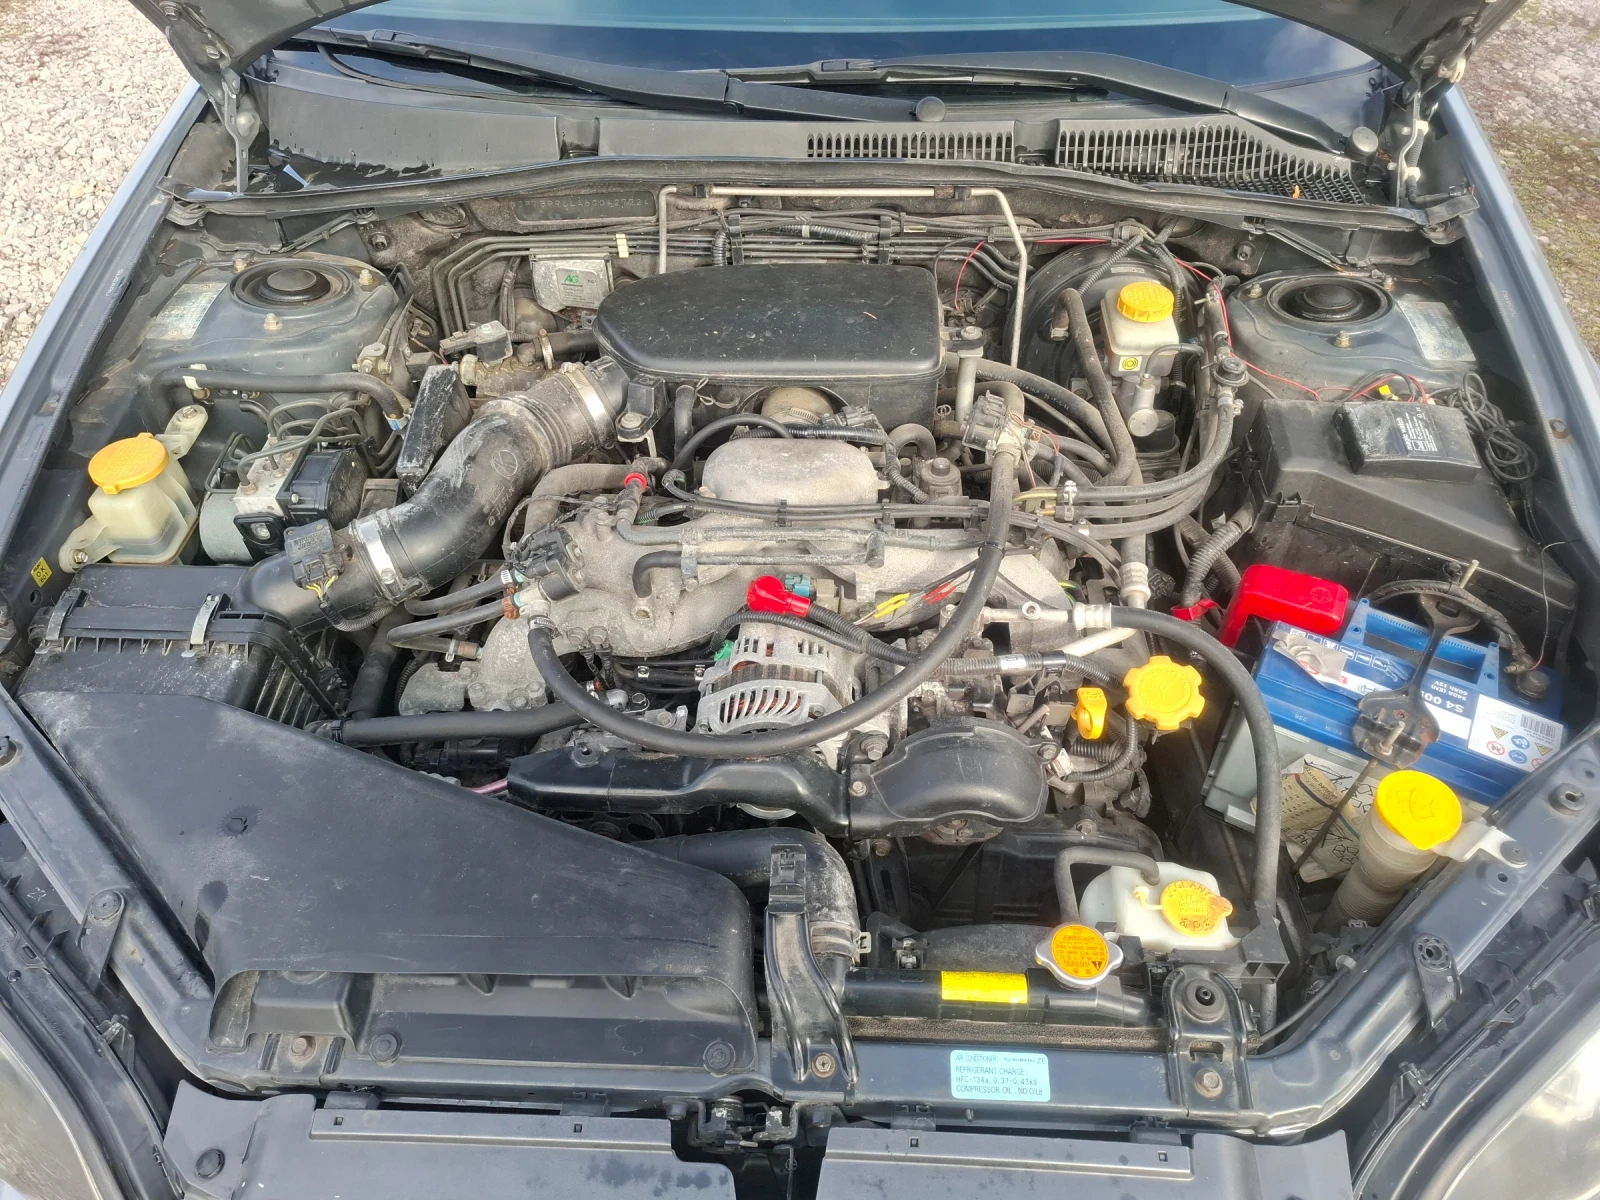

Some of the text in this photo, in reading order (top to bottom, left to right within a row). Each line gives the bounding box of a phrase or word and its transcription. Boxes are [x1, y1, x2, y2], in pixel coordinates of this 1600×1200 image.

[36, 566, 46, 577] OK
[1431, 684, 1446, 693] (EN)
[1450, 686, 1468, 696] 60Ah
[1446, 700, 1464, 713] S4
[1295, 834, 1308, 845] Pb
[1165, 882, 1211, 897] COOLANT
[965, 1055, 997, 1063] CONDITIONER
[956, 1066, 997, 1074] REFRIGERANT
[956, 1085, 1000, 1094] COMPRESSOR
